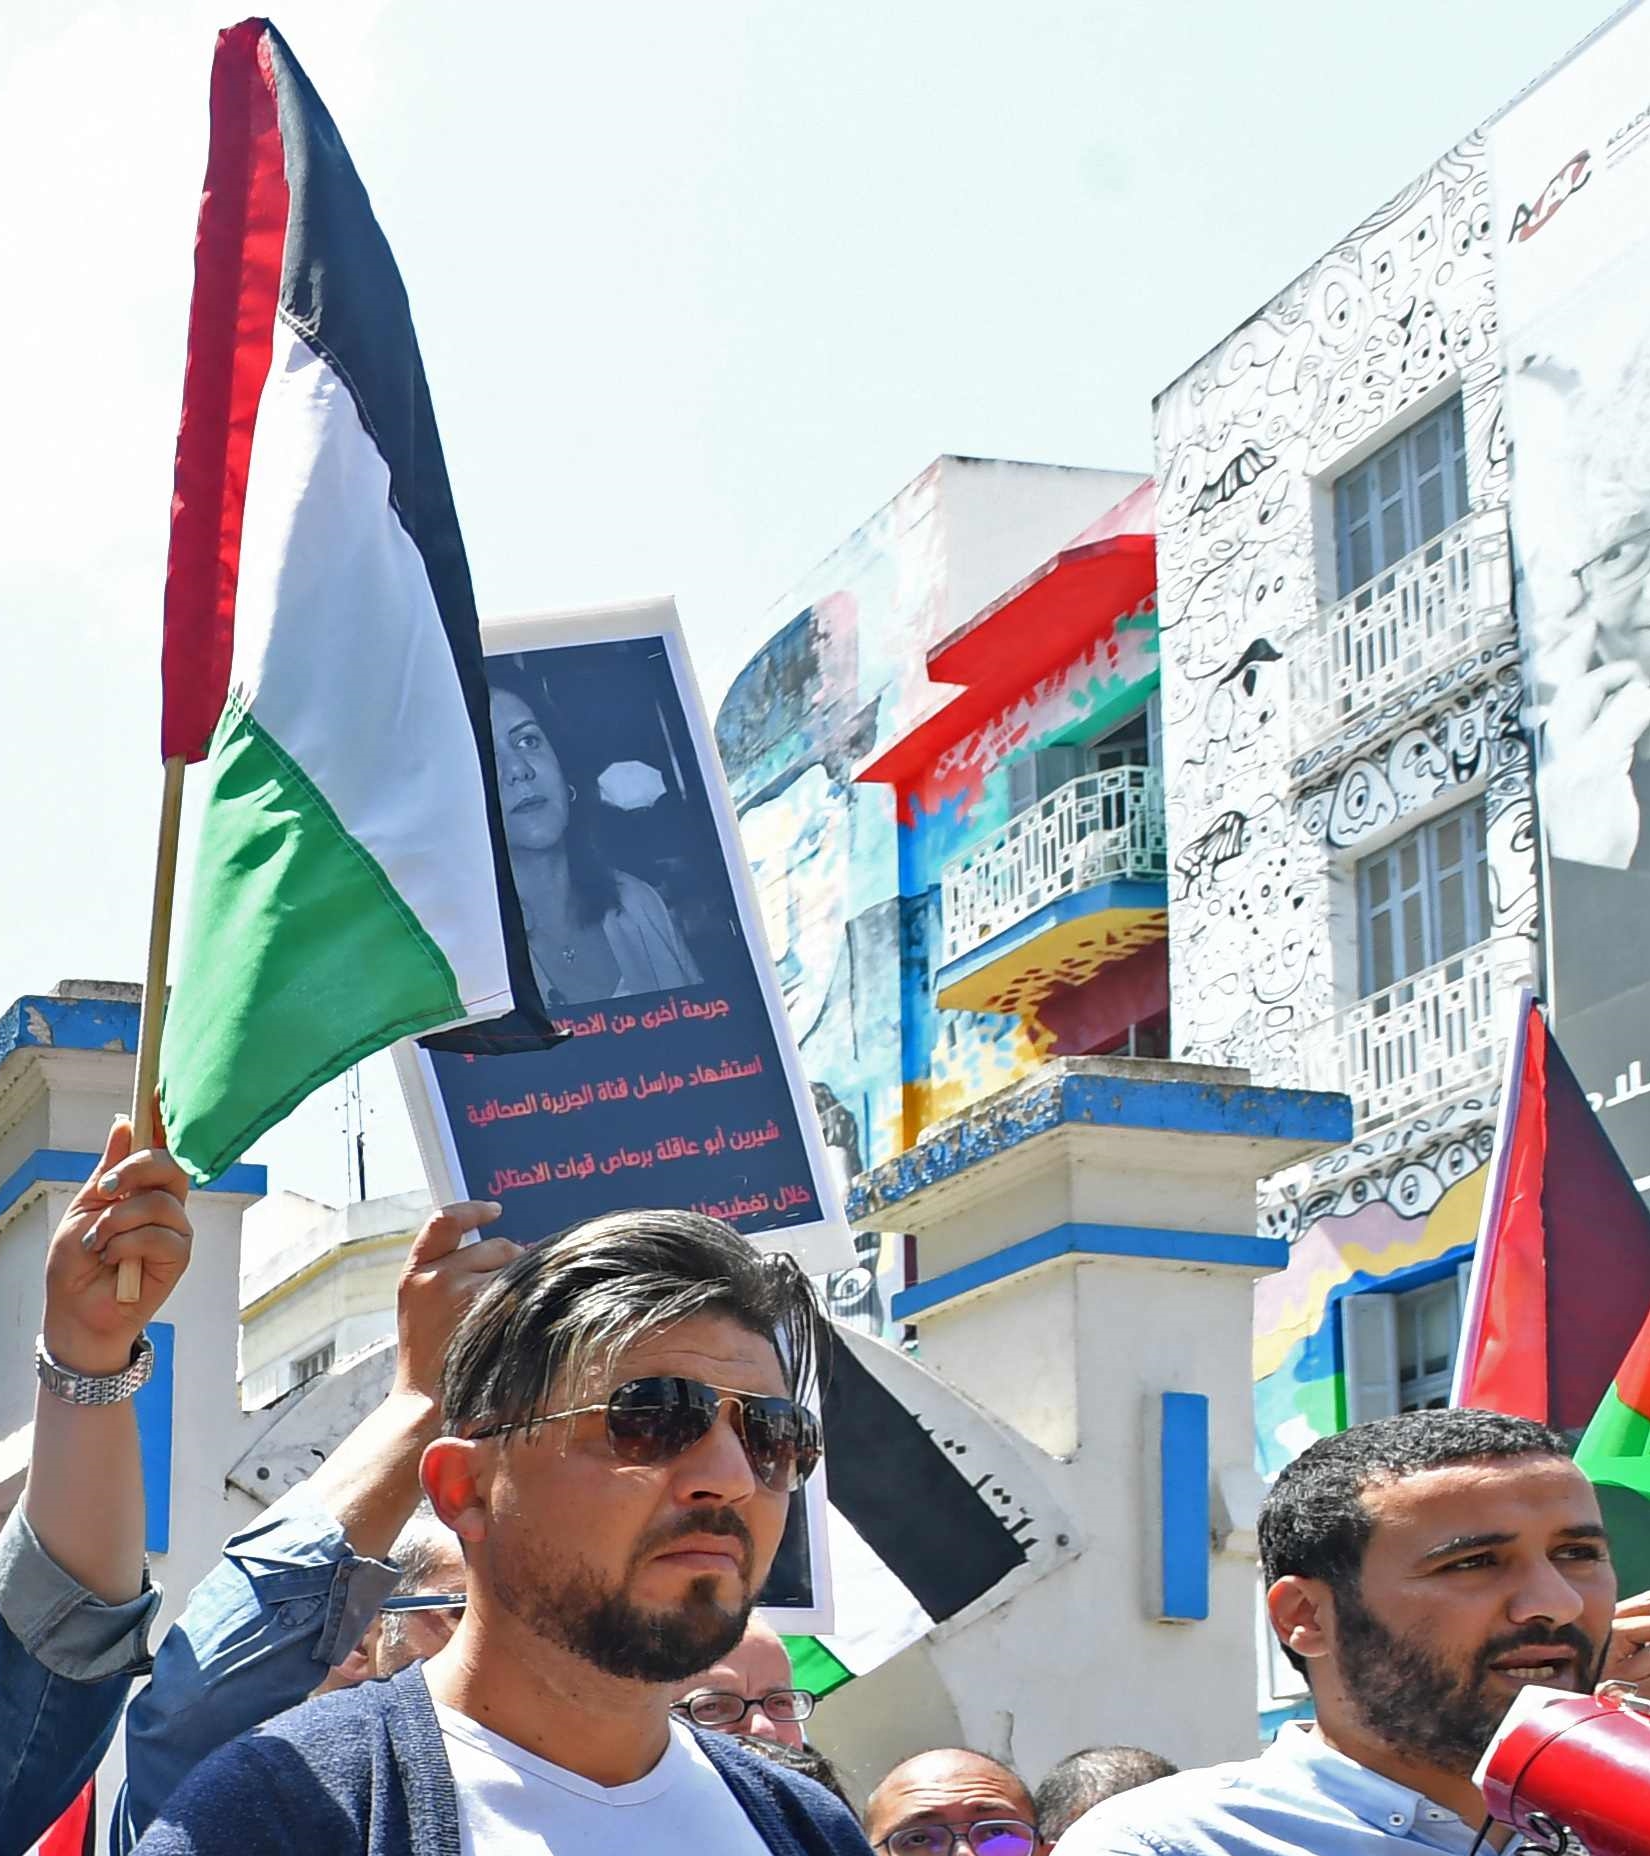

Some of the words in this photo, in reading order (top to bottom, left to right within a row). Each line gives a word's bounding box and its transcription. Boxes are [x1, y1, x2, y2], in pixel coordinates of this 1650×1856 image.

[641, 996, 679, 1029] أخرى
[681, 998, 731, 1020] جريمة
[611, 1014, 636, 1035] من
[688, 1054, 763, 1086] استشهاد
[598, 1076, 629, 1101] قناة
[633, 1071, 684, 1099] مراسل
[467, 1093, 538, 1127] الصحافية
[541, 1084, 594, 1115] الجزيرة
[655, 1135, 700, 1161] عاقلة
[704, 1125, 726, 1156] أبو
[729, 1119, 780, 1150] شيرين
[555, 1152, 595, 1179] قوات
[600, 1148, 653, 1175] برصاص
[488, 1161, 551, 1196] الاحتلال
[773, 1184, 811, 1212] خلال
